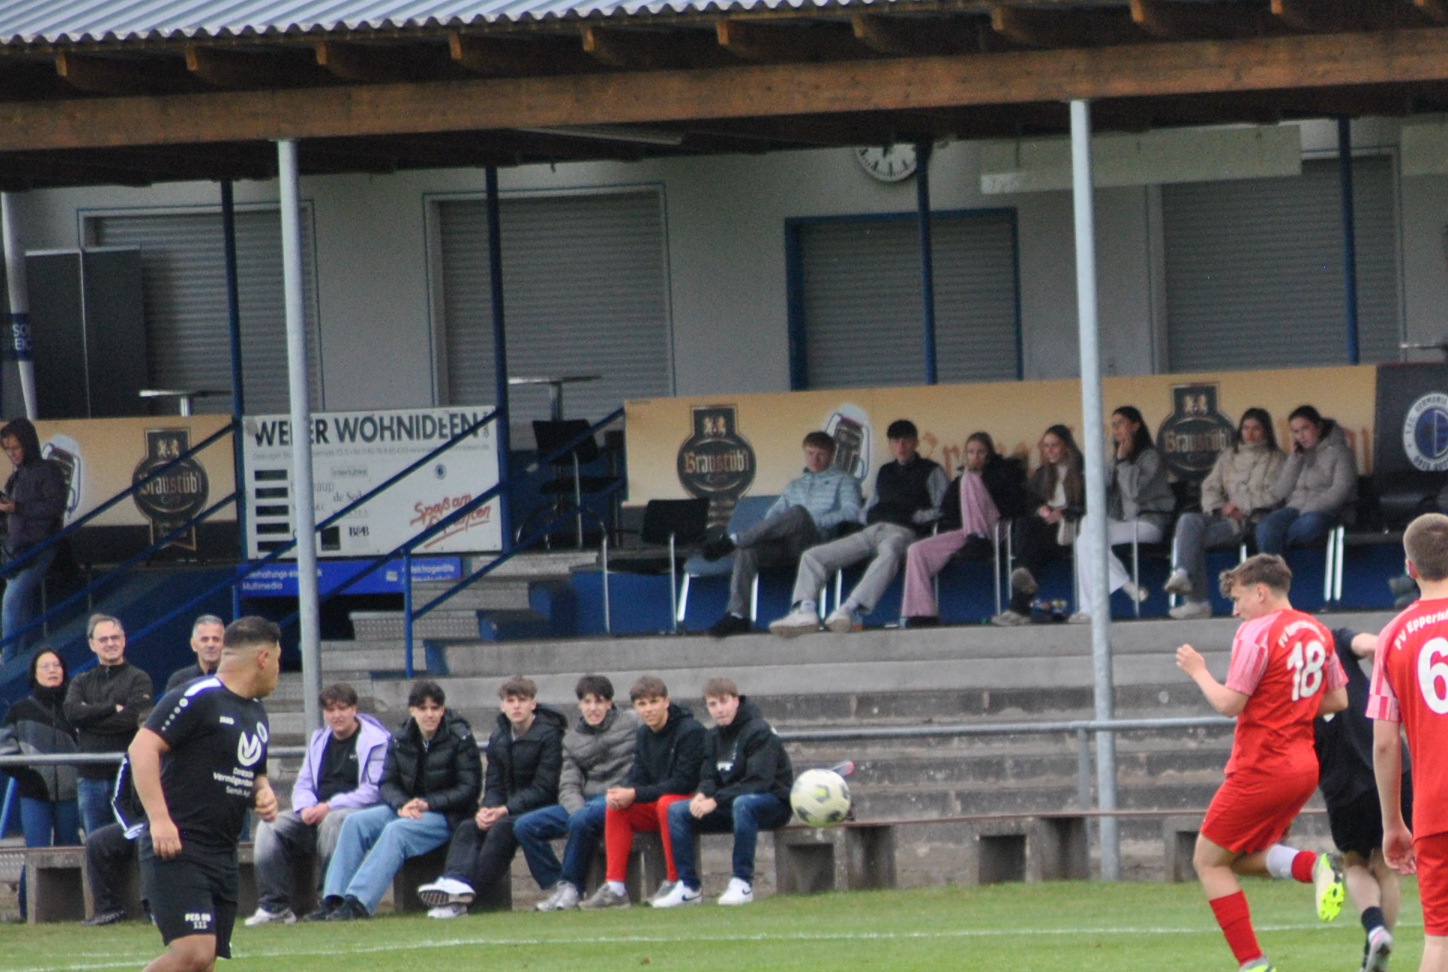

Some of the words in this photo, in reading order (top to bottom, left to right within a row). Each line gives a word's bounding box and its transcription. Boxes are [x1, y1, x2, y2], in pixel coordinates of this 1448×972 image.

[254, 418, 330, 447] WEER
[333, 411, 480, 444] WOHNIDEEN
[1394, 629, 1408, 651] FV
[1286, 640, 1327, 702] 18
